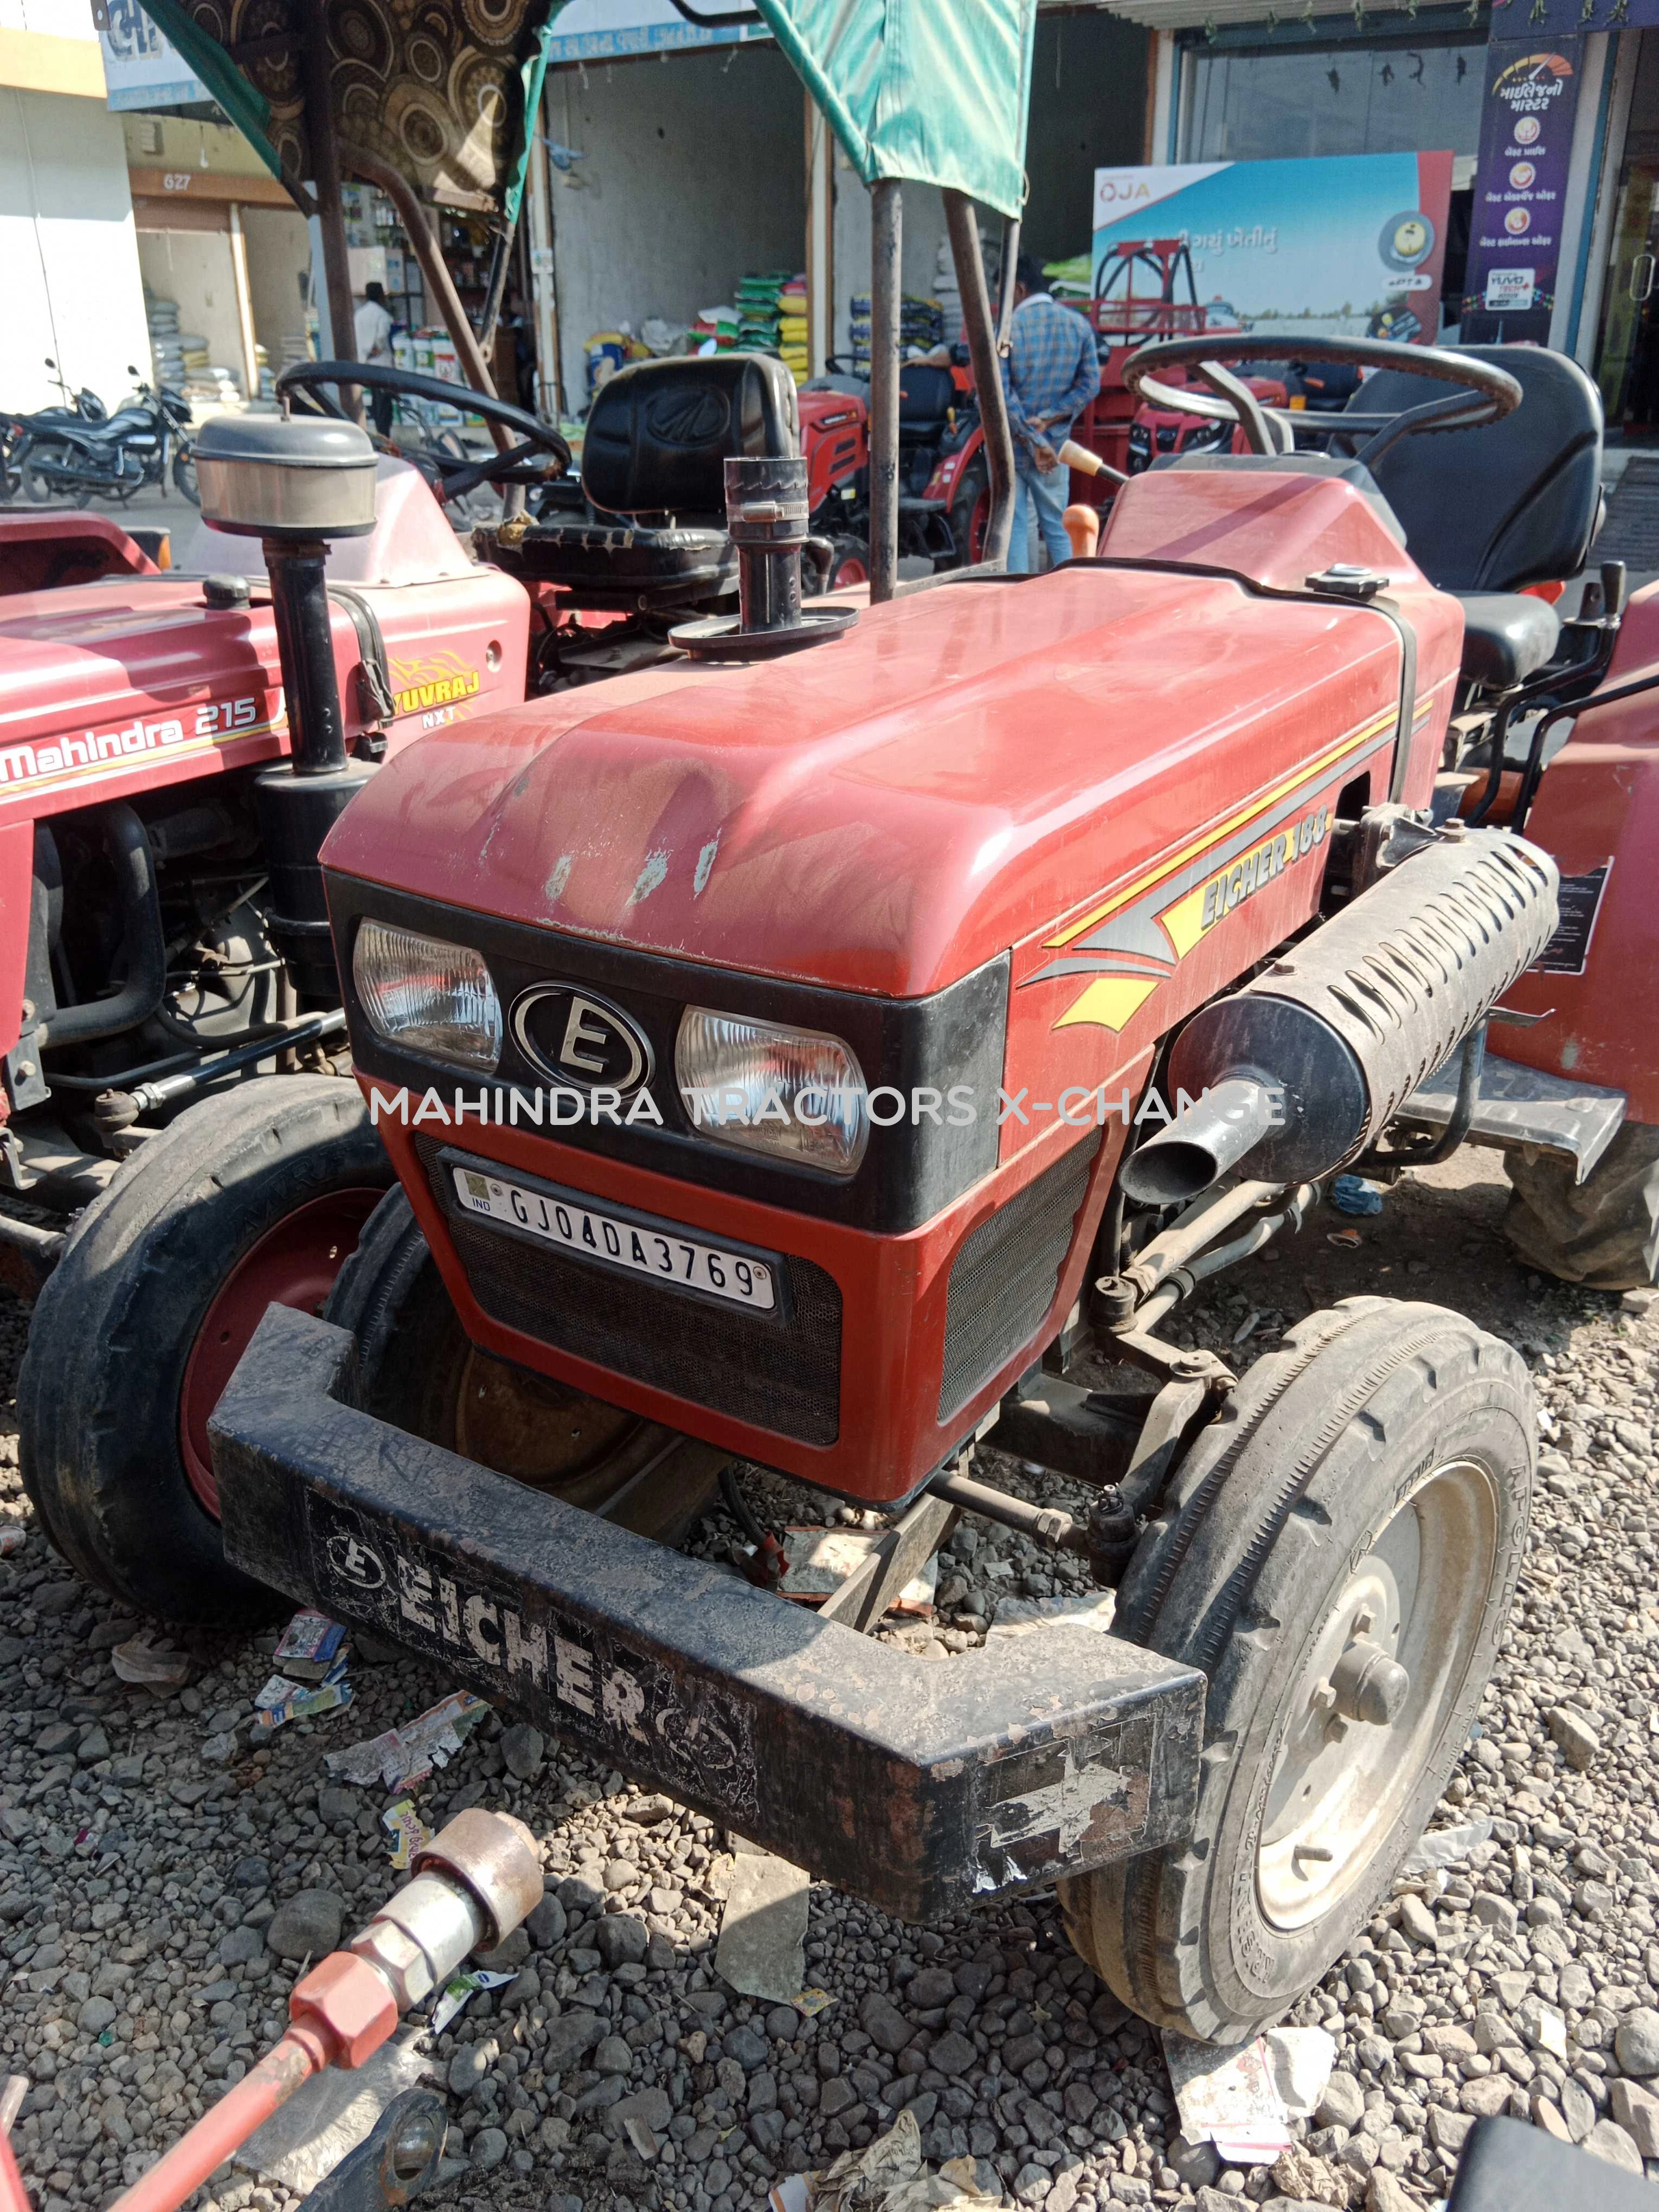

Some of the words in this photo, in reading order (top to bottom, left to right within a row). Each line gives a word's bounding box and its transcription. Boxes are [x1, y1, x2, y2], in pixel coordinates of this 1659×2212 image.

[1510, 98, 1549, 112] માસ્ટર
[164, 173, 191, 190] G27
[1100, 182, 1149, 202] OJA
[394, 670, 480, 716] YUVRAJ
[0, 719, 183, 782] Mahindra
[195, 697, 256, 735] 215
[422, 706, 455, 729] NXT
[1201, 834, 1287, 931] EICHER
[1291, 805, 1327, 864] 188
[559, 997, 608, 1073] E
[473, 1198, 490, 1211] IND
[510, 1189, 753, 1296] GJ04DA3769
[397, 1554, 650, 1747] EICHER
